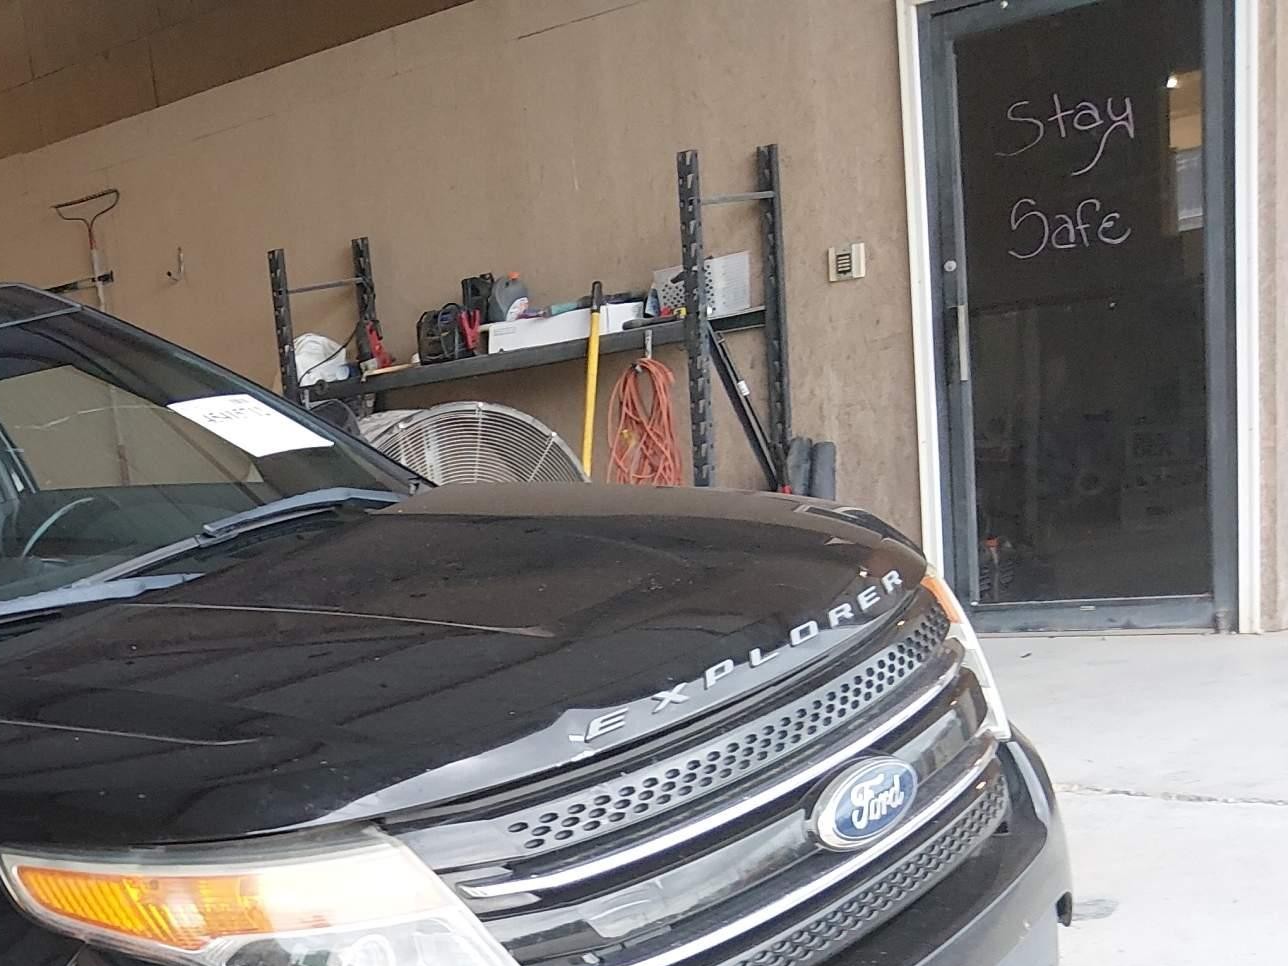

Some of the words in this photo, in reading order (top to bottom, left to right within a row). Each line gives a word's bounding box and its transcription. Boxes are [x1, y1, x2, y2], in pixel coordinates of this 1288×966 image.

[994, 93, 1135, 176] Stay
[1007, 198, 1131, 259] Safe
[582, 568, 904, 742] EXPLORER
[850, 773, 905, 830] Ford
